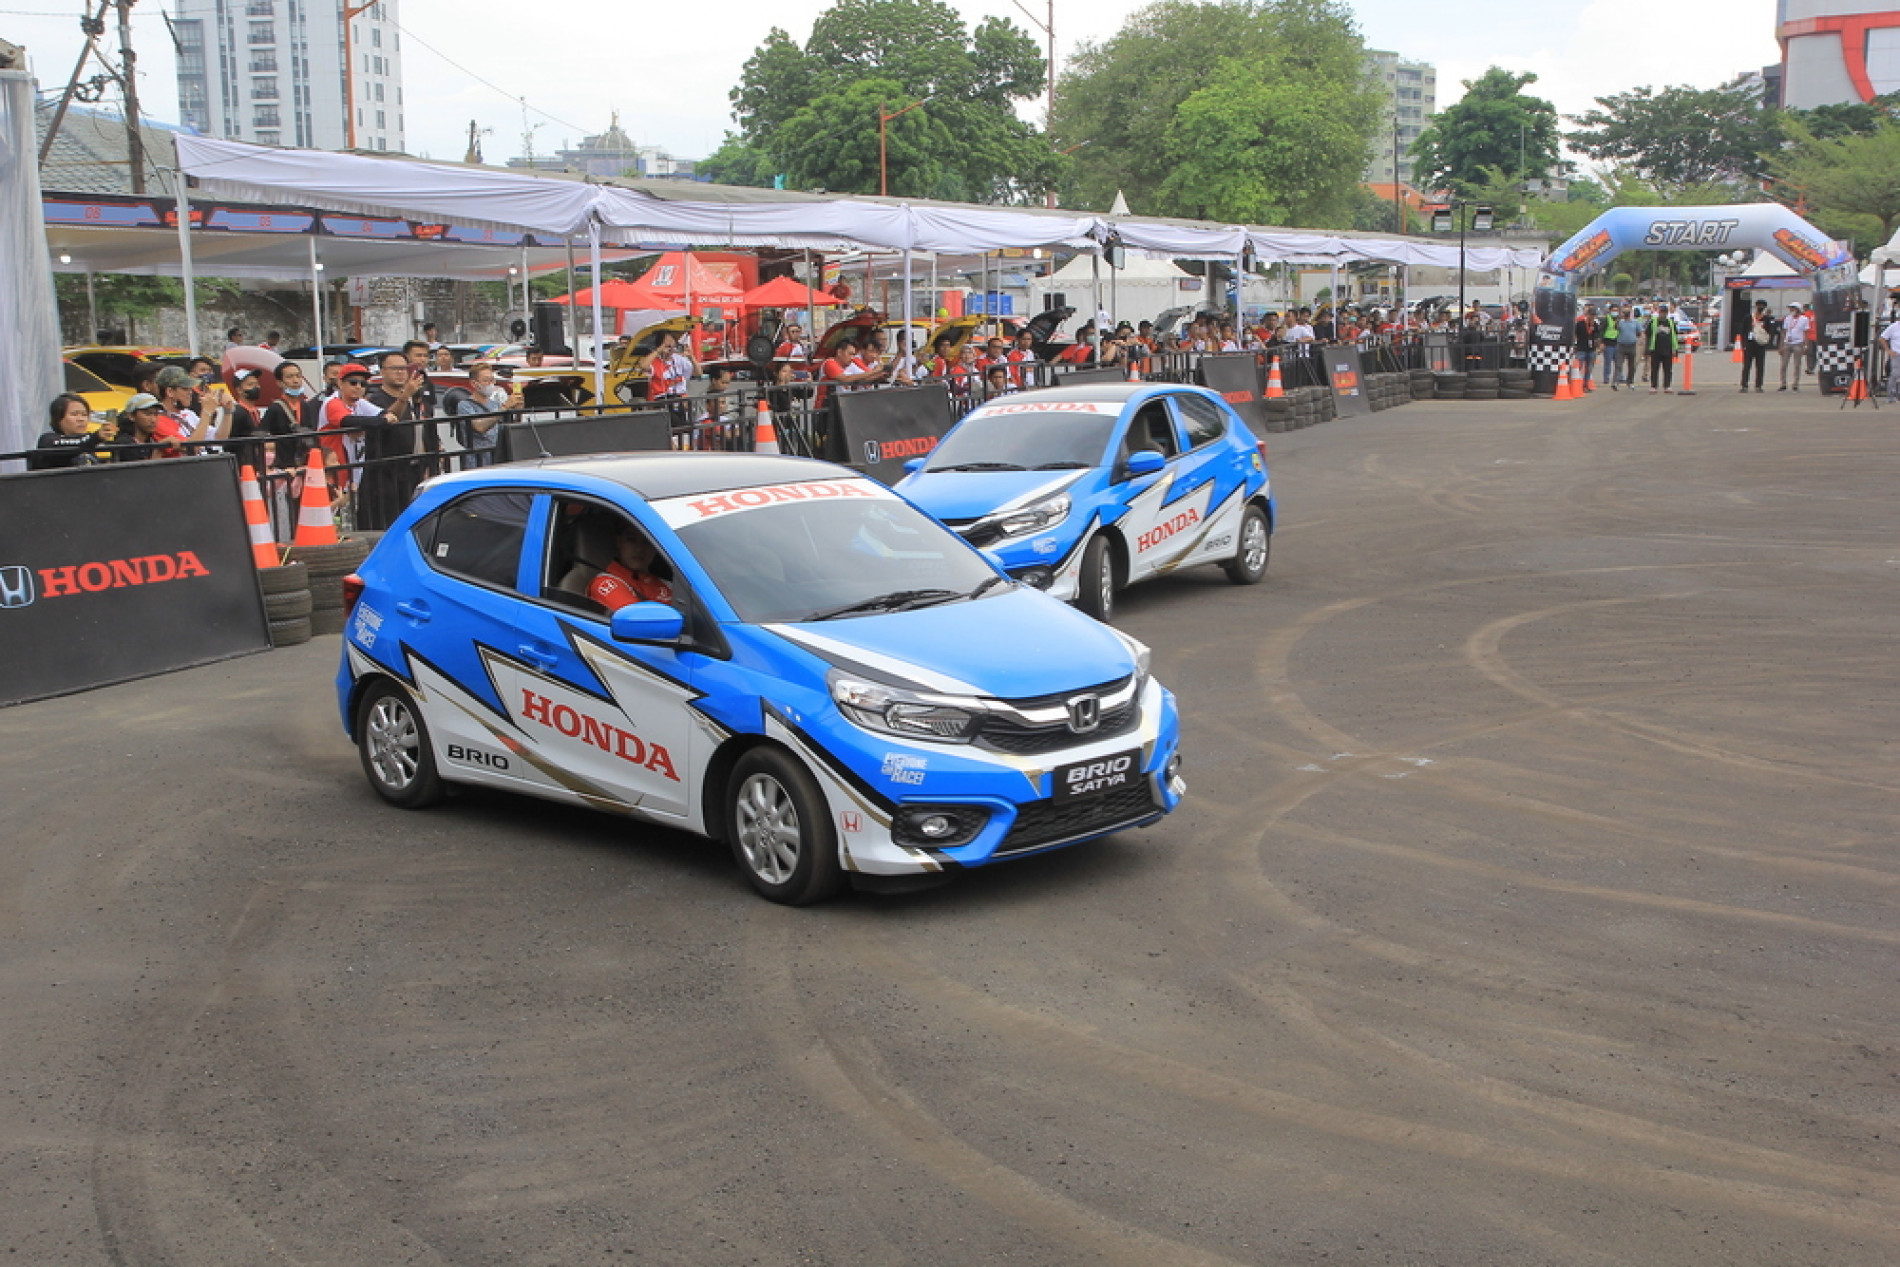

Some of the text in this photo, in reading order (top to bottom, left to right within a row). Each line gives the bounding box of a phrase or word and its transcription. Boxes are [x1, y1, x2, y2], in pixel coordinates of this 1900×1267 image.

[1645, 218, 1739, 246] START
[984, 402, 1098, 416] HONDA
[879, 434, 938, 460] HONDA
[690, 482, 873, 517] HONDA
[1136, 507, 1200, 554] HONDA
[36, 550, 211, 598] HONDA
[520, 688, 681, 782] HONDA
[448, 744, 509, 770] BRIO
[1066, 755, 1131, 784] BRIO
[1069, 773, 1126, 795] SATYA
